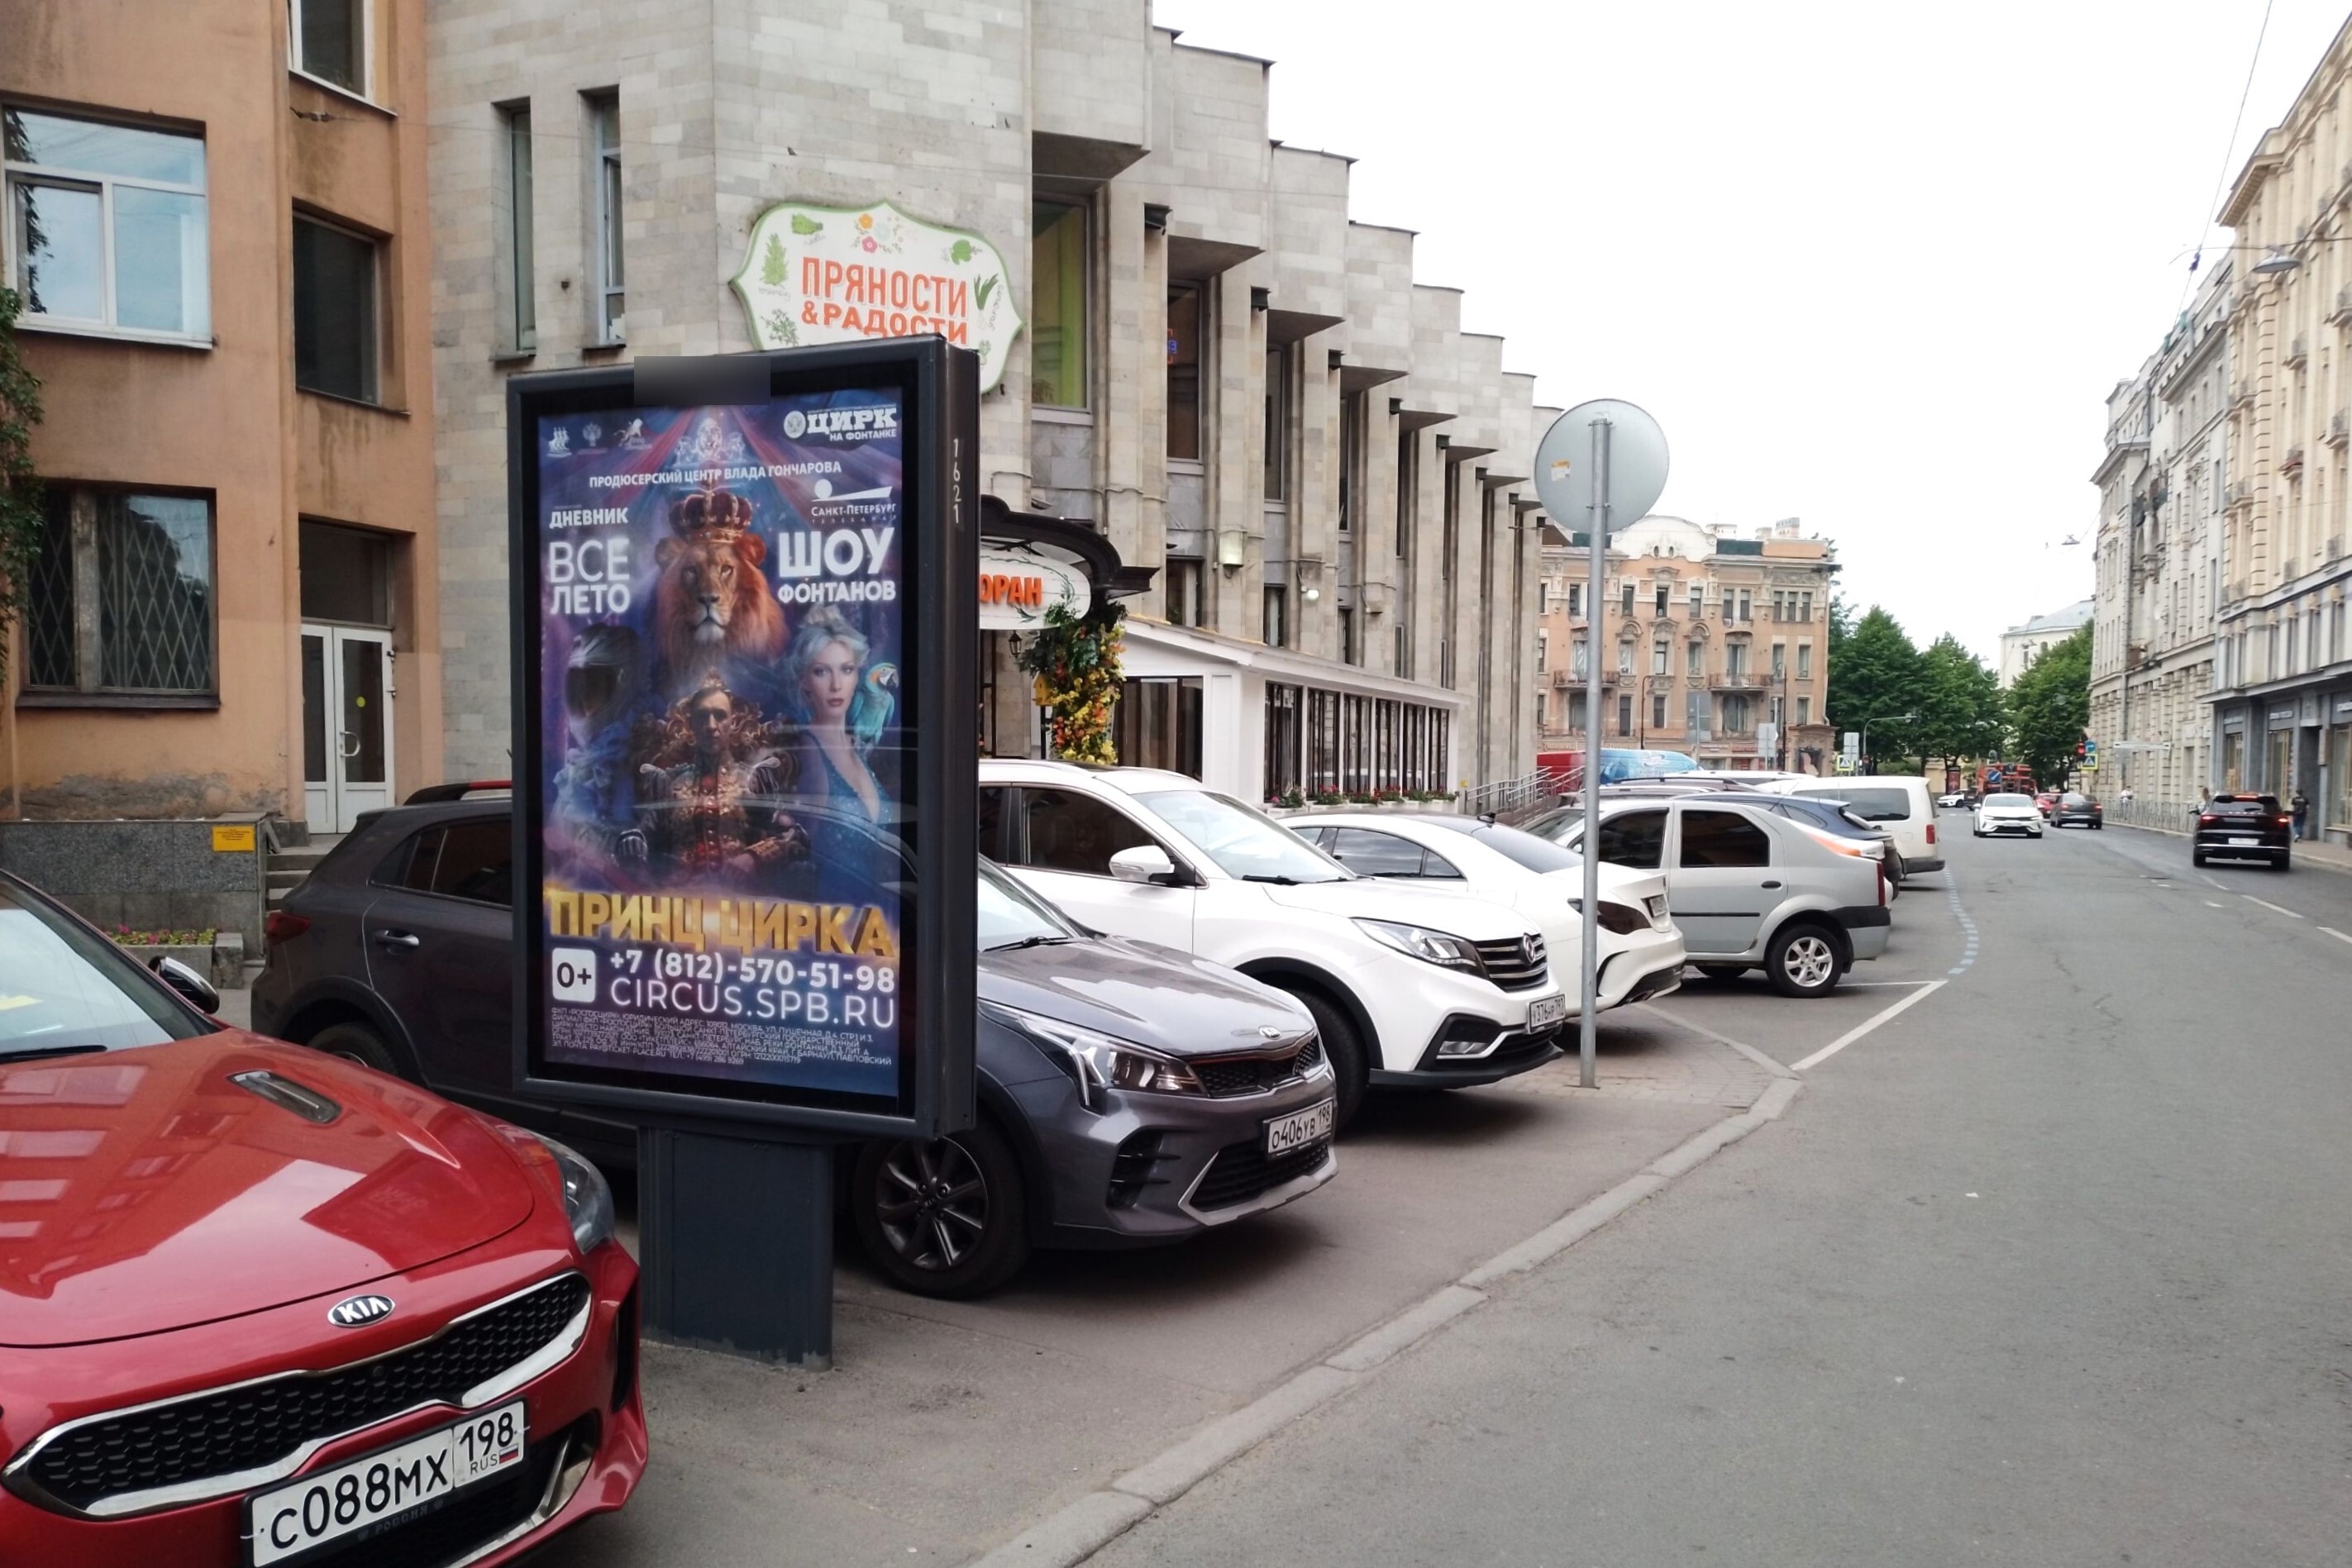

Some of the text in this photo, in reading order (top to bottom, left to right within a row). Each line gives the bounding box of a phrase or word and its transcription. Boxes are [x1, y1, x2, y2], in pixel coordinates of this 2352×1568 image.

[803, 257, 967, 317] ПРЯНОСТИ
[807, 407, 897, 435] ЦИРК
[829, 428, 897, 442] НА ФОНТАНКЕ
[589, 460, 842, 489] ПРОДЮСЕРСКИЙ ЦЕНТР ВЛАДА ГОНЧАРОВА
[549, 507, 628, 529] ДНЕВНИК
[549, 538, 631, 583] ВСЕ
[778, 527, 895, 579] ШОУ
[550, 584, 631, 615] ЛЕТО
[778, 579, 897, 603] ФОНТАНОВ
[549, 890, 896, 958] ПРИНЦ ЦИРКА
[556, 962, 593, 989] 0+
[610, 948, 896, 994] +7 (812)-570-51-98
[610, 978, 895, 1030] CIRCUS.SPB.RU
[1271, 1103, 1331, 1150] О406УВ 198
[336, 1298, 390, 1323] KIA
[270, 1410, 514, 1549] С088МХ 198
[470, 1453, 499, 1475] RUS
